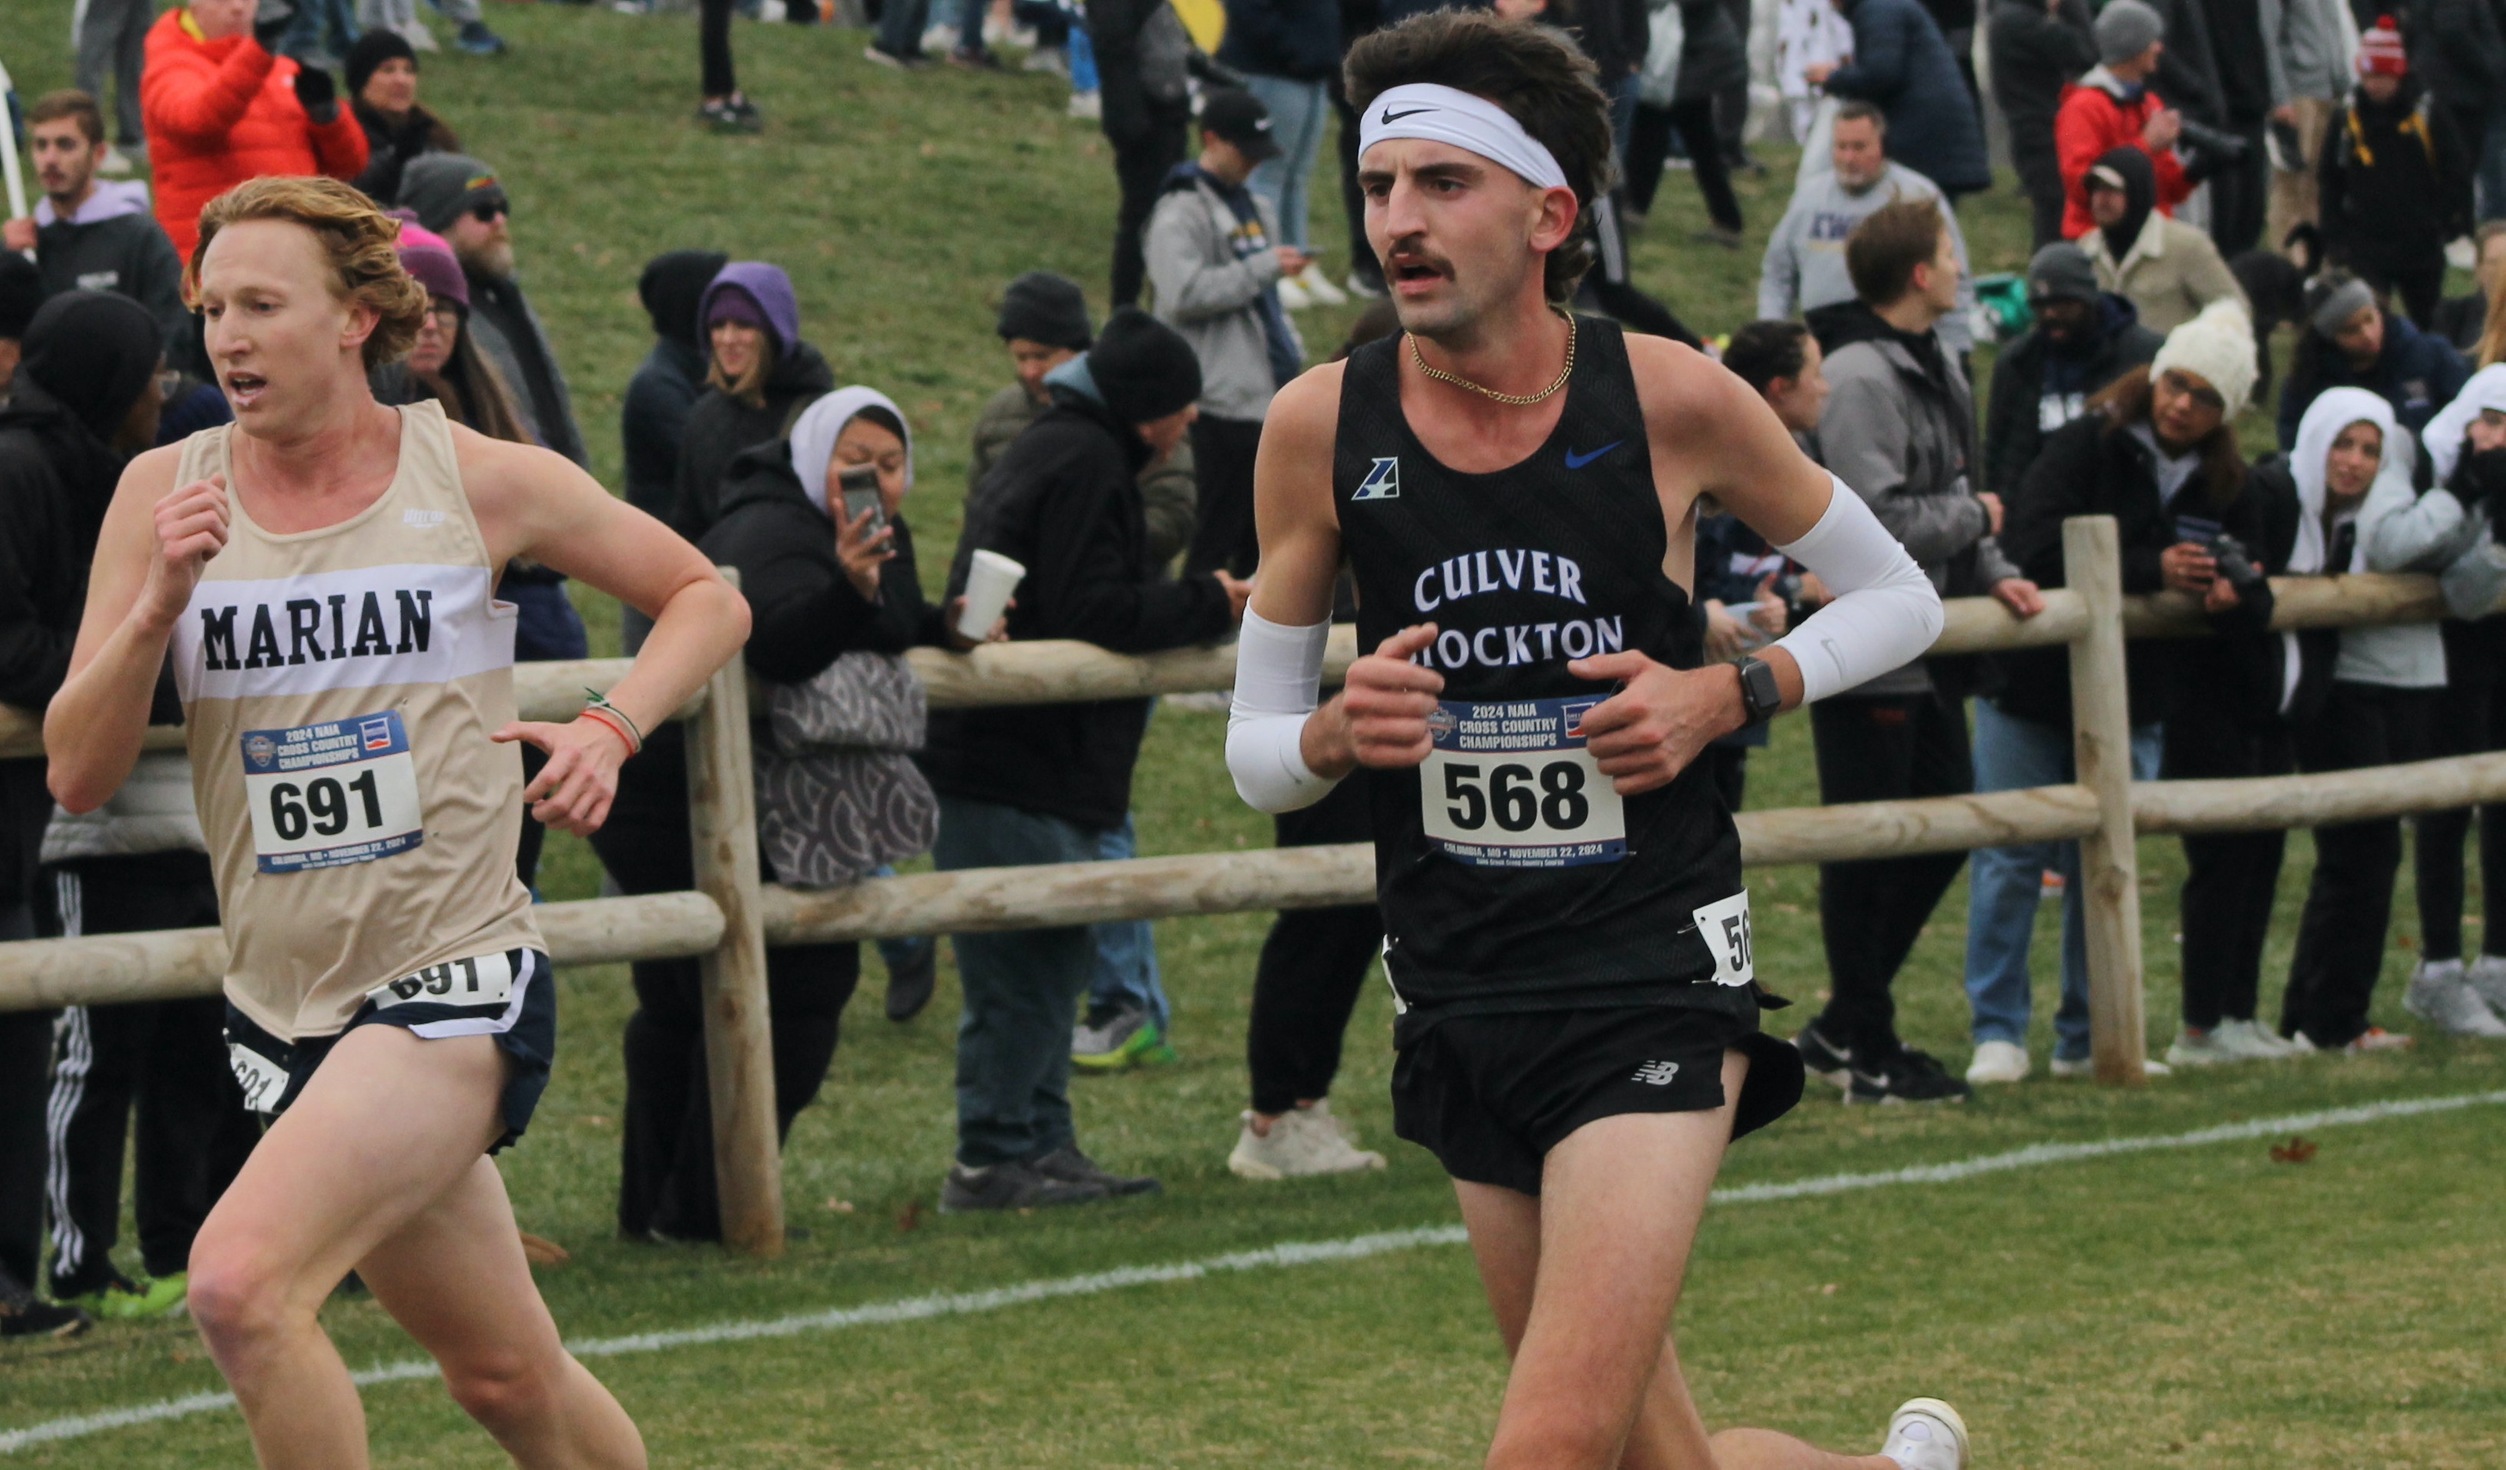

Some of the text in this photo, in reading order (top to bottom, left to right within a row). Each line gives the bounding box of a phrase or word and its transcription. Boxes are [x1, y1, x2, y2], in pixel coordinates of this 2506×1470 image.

[1414, 549, 1587, 613] CULVER
[201, 590, 432, 670] MARIAN
[1398, 615, 1623, 669] OCKTON
[1472, 702, 1538, 719] 2024 NAIA
[285, 723, 340, 743] 2024 NAIA
[1459, 720, 1498, 734] CROSS
[1502, 717, 1557, 734] COUNTRY
[277, 742, 310, 757] CROSS
[311, 734, 358, 752] COUNTRY
[1459, 733, 1557, 749] CHAMPIONSHIPS
[278, 747, 360, 770] CHAMPIONSHIPS
[270, 769, 383, 841] 691
[1443, 760, 1589, 832] 568
[1444, 841, 1603, 859] COLUMBIA, MO NOVEMBER 22, 2024
